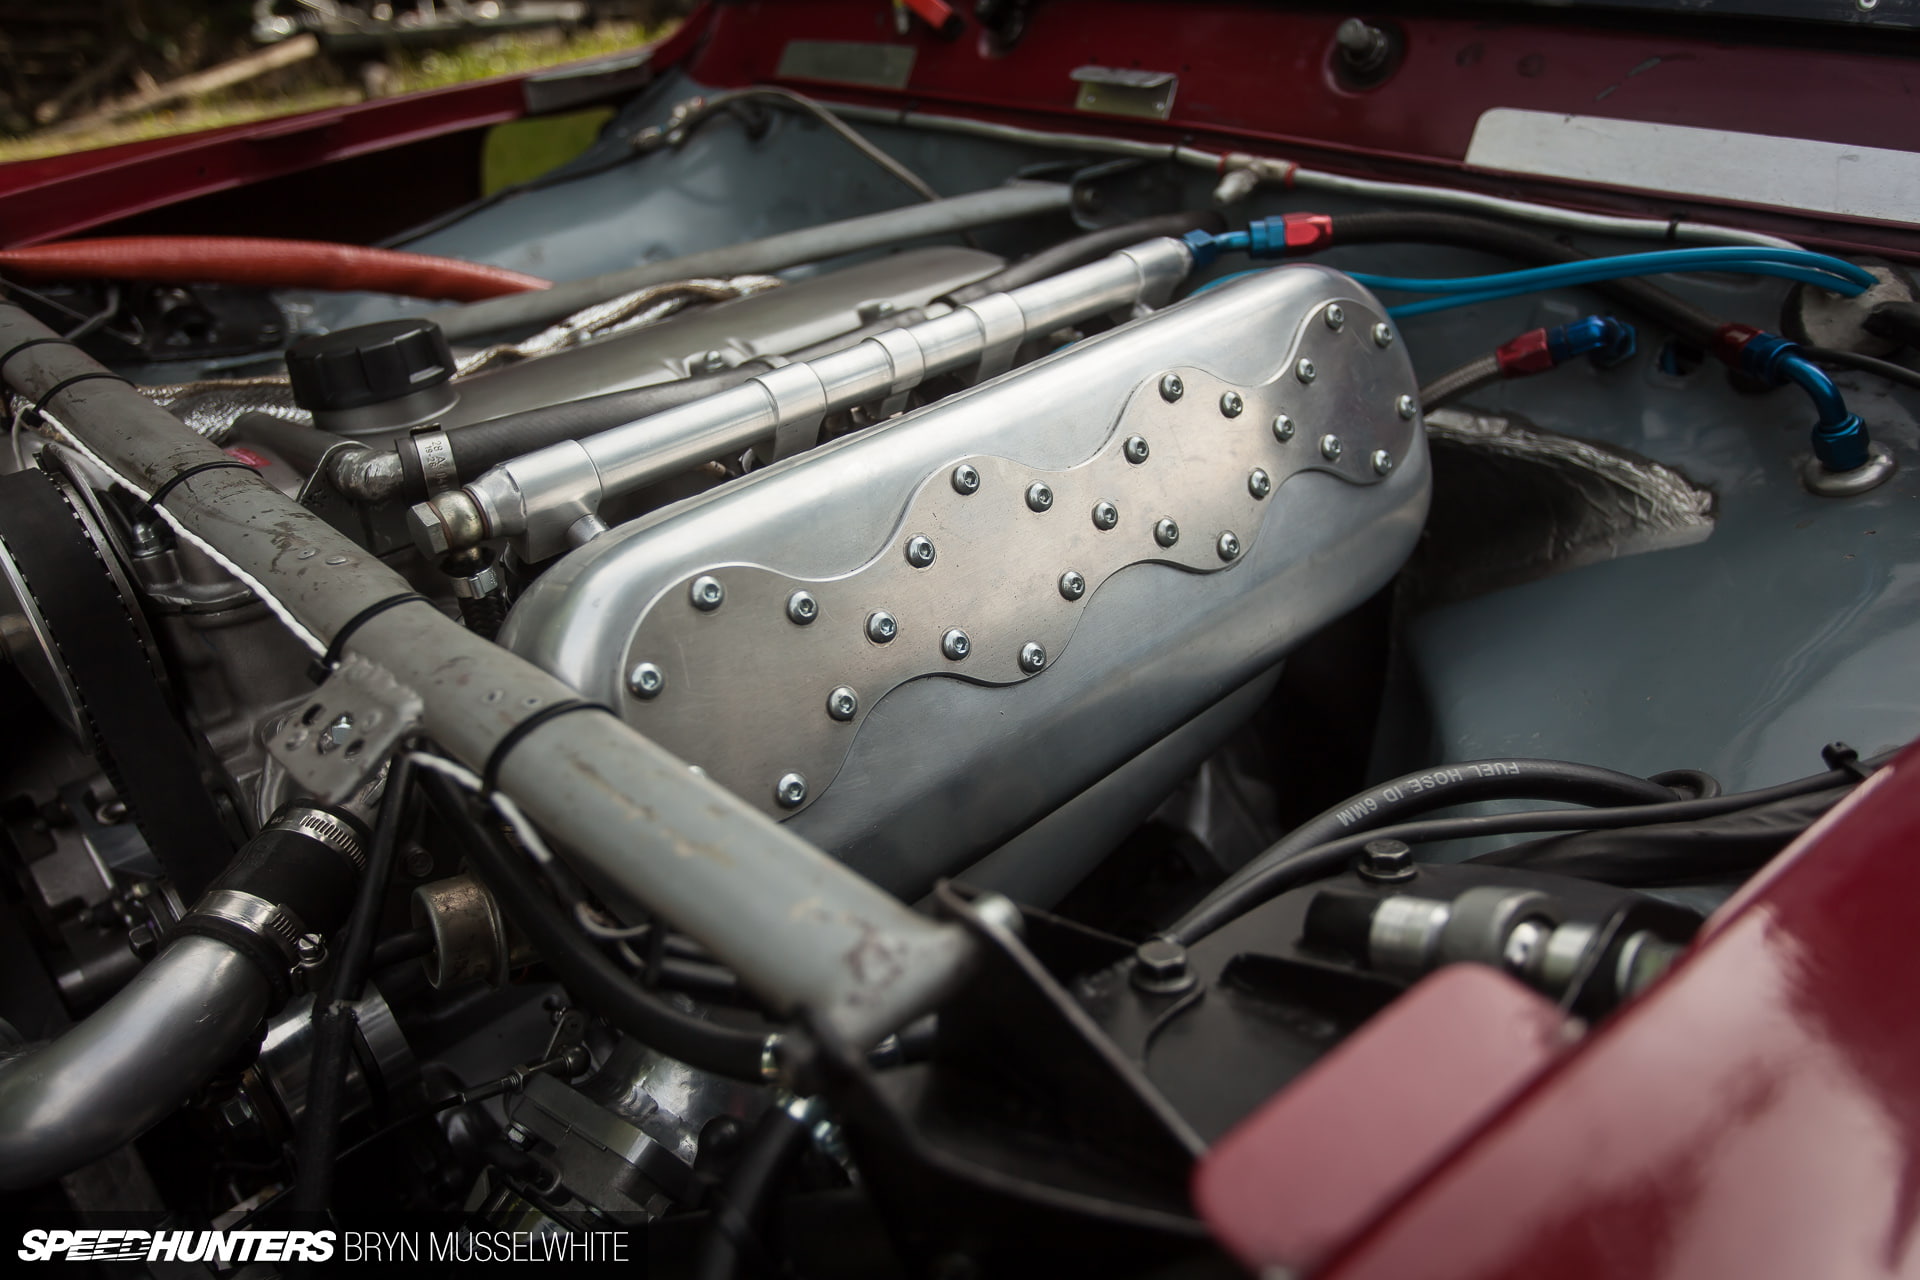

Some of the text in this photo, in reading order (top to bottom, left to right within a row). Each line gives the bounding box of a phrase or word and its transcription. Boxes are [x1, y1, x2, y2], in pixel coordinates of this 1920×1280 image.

[1336, 762, 1520, 826] FUEL HOSE ID 6MM
